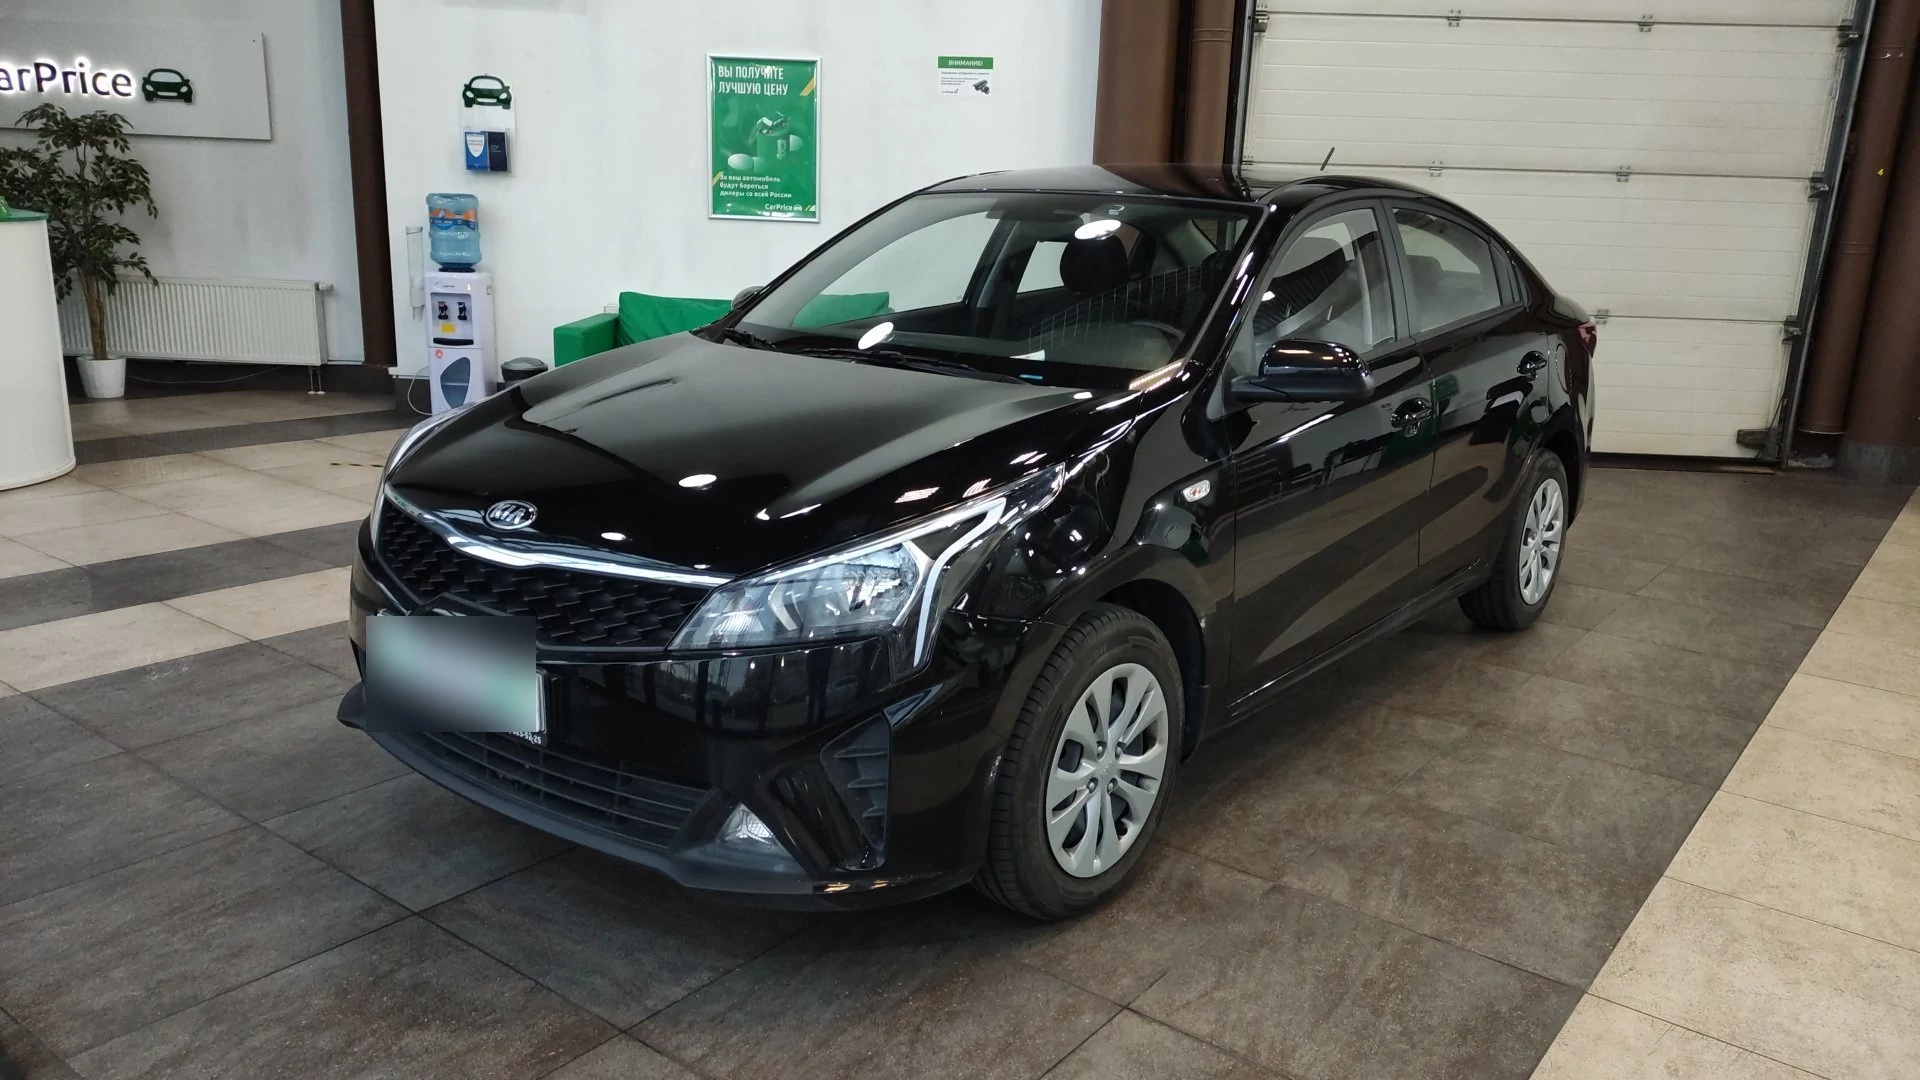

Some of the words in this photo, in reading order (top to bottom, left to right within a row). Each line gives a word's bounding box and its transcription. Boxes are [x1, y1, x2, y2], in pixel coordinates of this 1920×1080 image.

[718, 65, 733, 78] ВЫ
[735, 66, 784, 80] ПОЛУЧИТЕ
[718, 81, 761, 95] ЛУЧШУЮ
[763, 82, 789, 96] ЦЕНУ
[742, 175, 781, 183] автомобиль
[719, 181, 739, 189] будут
[739, 182, 769, 190] бороться
[764, 203, 793, 211] CarPrice
[489, 502, 527, 526] KIA
